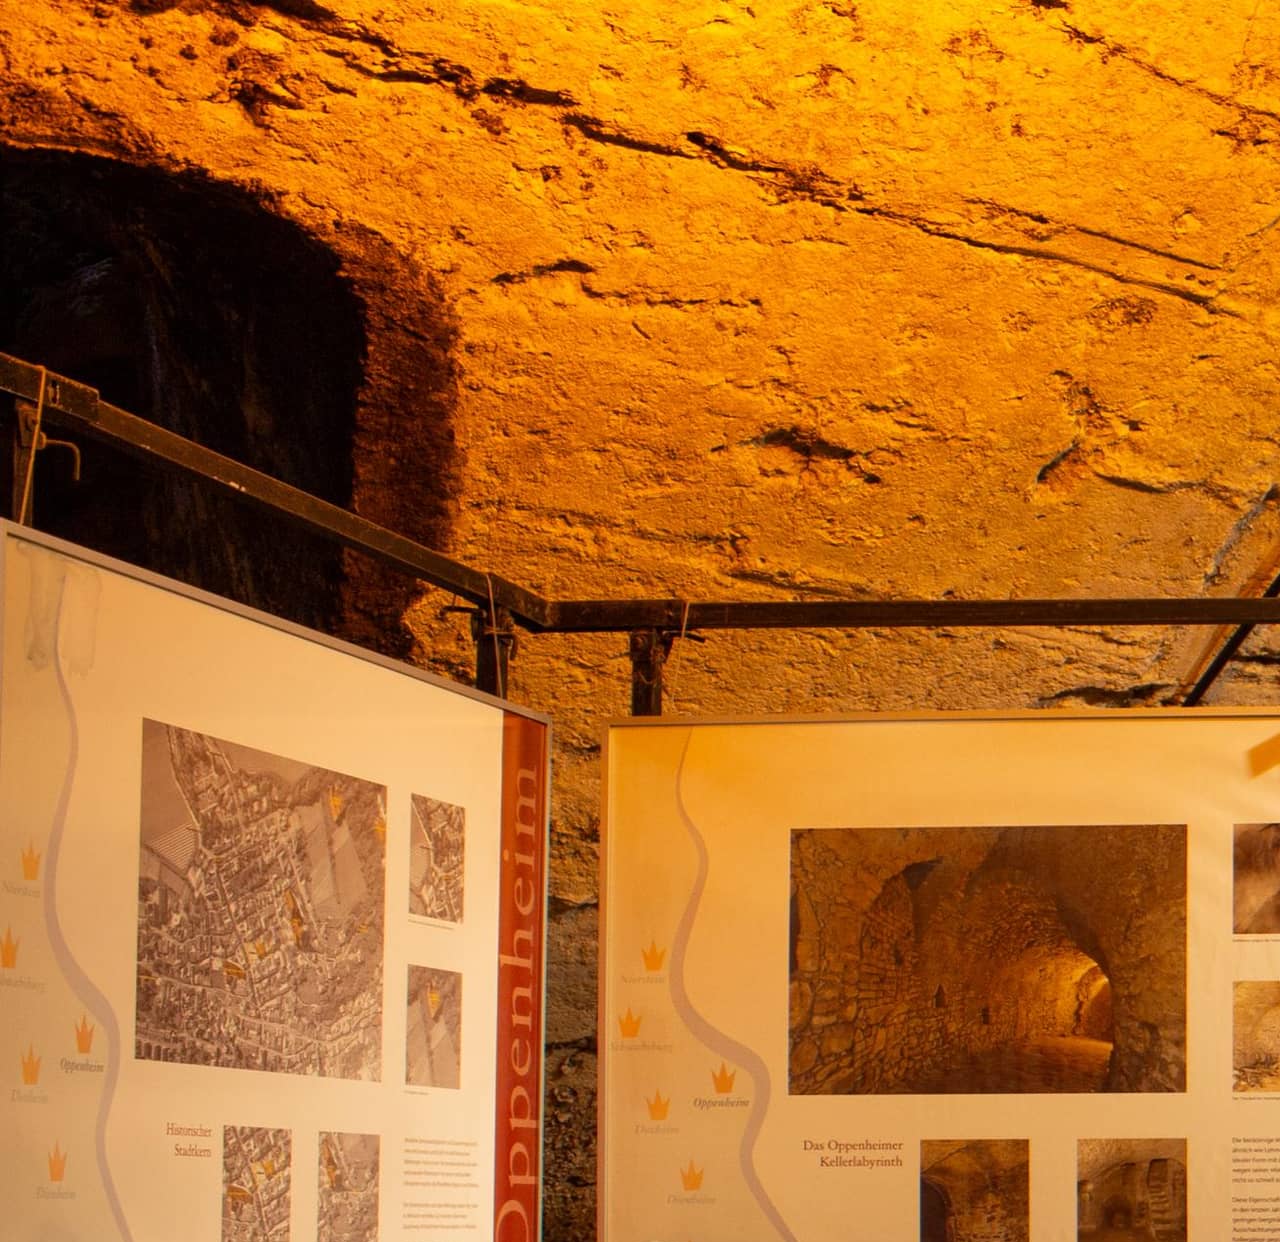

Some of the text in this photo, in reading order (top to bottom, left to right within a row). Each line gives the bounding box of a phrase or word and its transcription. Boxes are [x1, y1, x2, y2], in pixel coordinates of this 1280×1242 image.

[60, 1056, 104, 1074] Oppenheim
[693, 1096, 750, 1111] Oppenheim
[166, 1121, 212, 1138] Historischer
[174, 1143, 212, 1158] Stadtkern
[803, 1139, 904, 1153] Das Oppenheimer
[819, 1155, 903, 1170] Kellerlabyrinth
